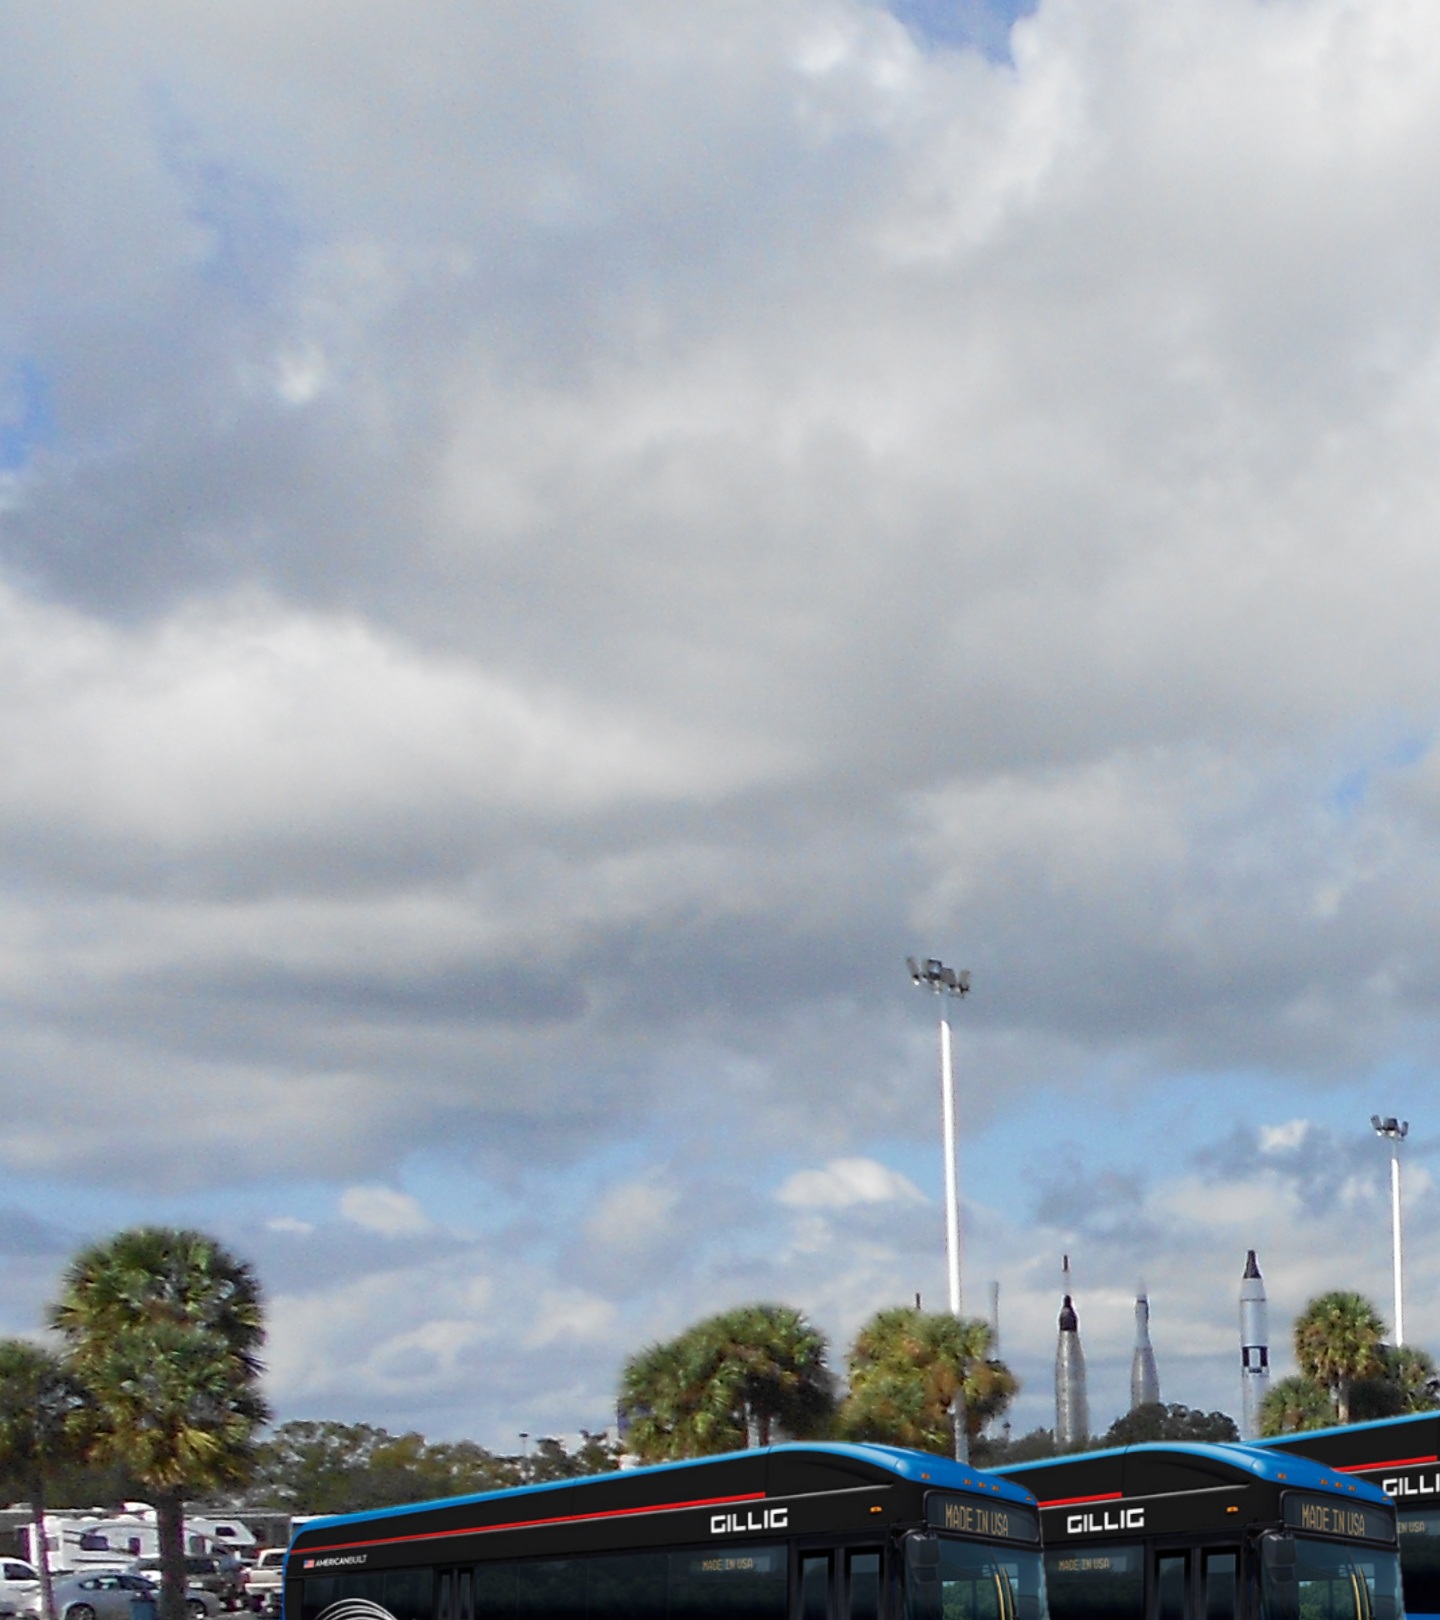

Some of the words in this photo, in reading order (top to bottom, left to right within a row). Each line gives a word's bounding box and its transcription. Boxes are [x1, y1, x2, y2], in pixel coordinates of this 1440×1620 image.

[710, 1507, 788, 1534] GILLIG
[945, 1505, 973, 1531] MADE
[975, 1509, 989, 1533] IN
[991, 1513, 1009, 1536] USA
[1066, 1507, 1145, 1534] GILLIG
[1301, 1505, 1329, 1530] MADE
[1332, 1508, 1345, 1534] IN
[1347, 1513, 1364, 1537] USA
